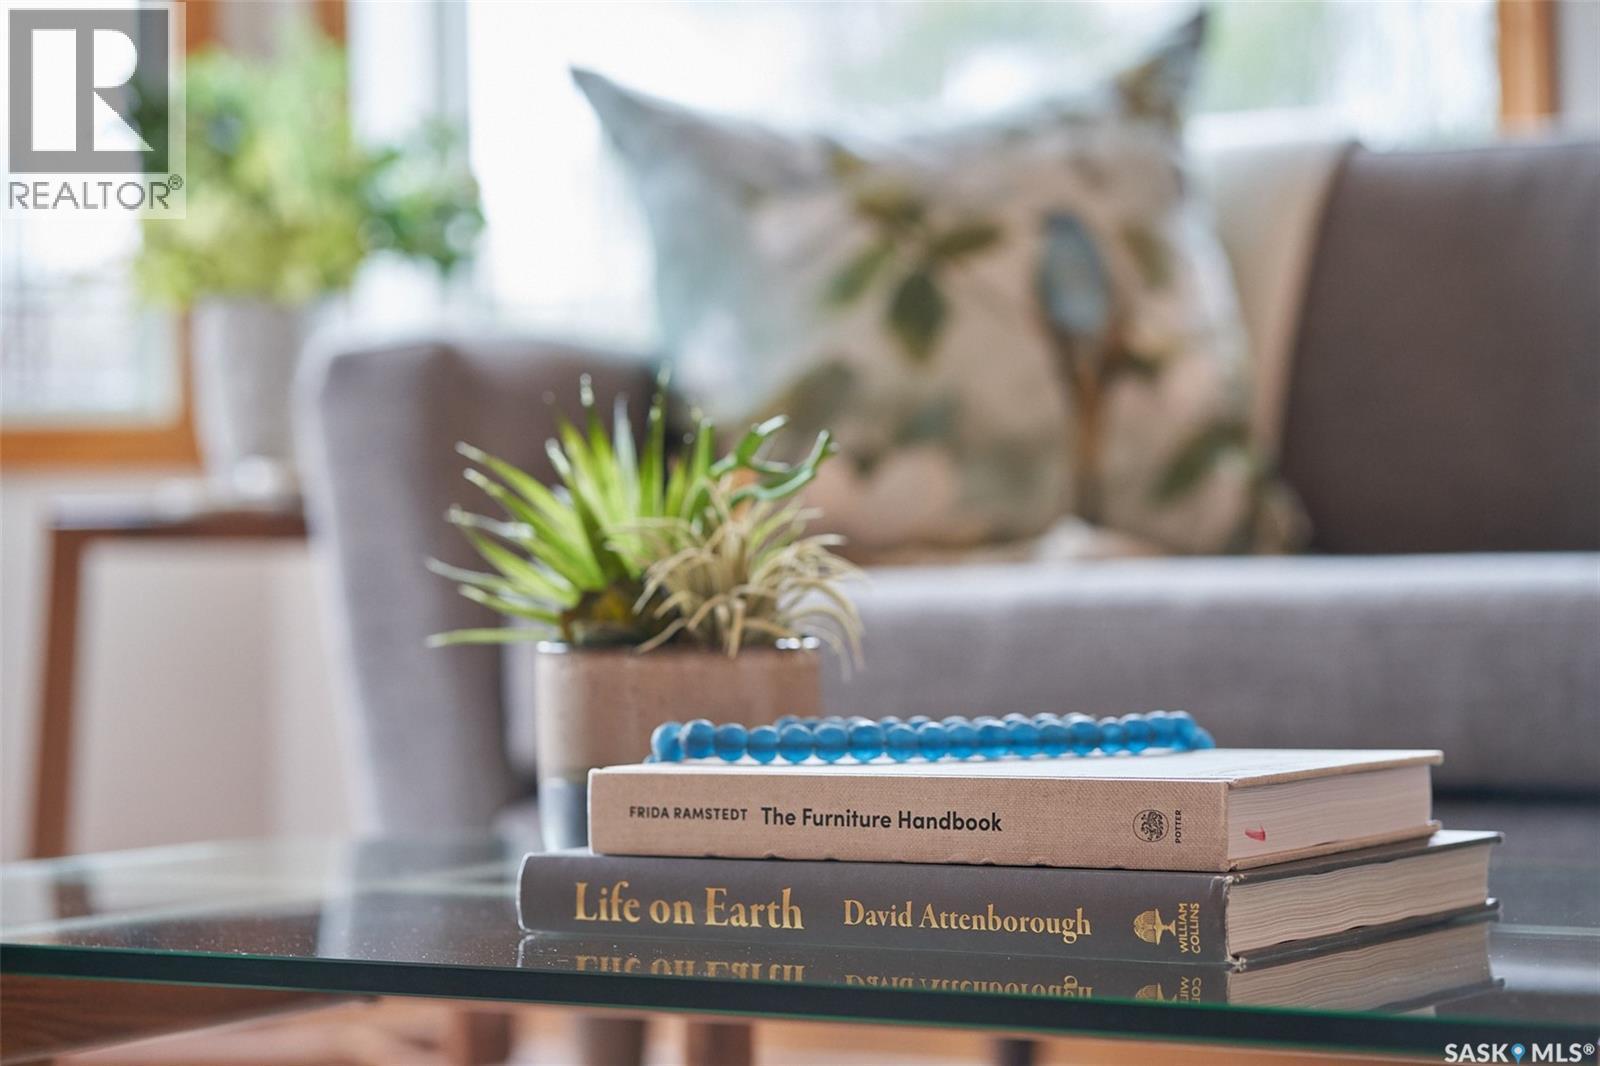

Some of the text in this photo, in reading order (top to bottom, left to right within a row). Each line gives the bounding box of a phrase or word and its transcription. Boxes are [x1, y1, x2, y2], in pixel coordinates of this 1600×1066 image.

[629, 806, 749, 821] FRIDA RAMSTEDT
[761, 807, 1003, 832] The Furniture Handbook
[1174, 809, 1183, 844] POTTER
[574, 880, 805, 930] Life on Earth
[843, 899, 1093, 944] David Attenborough
[1178, 902, 1190, 954] WILLIAM
[1190, 902, 1201, 954] COLLINS
